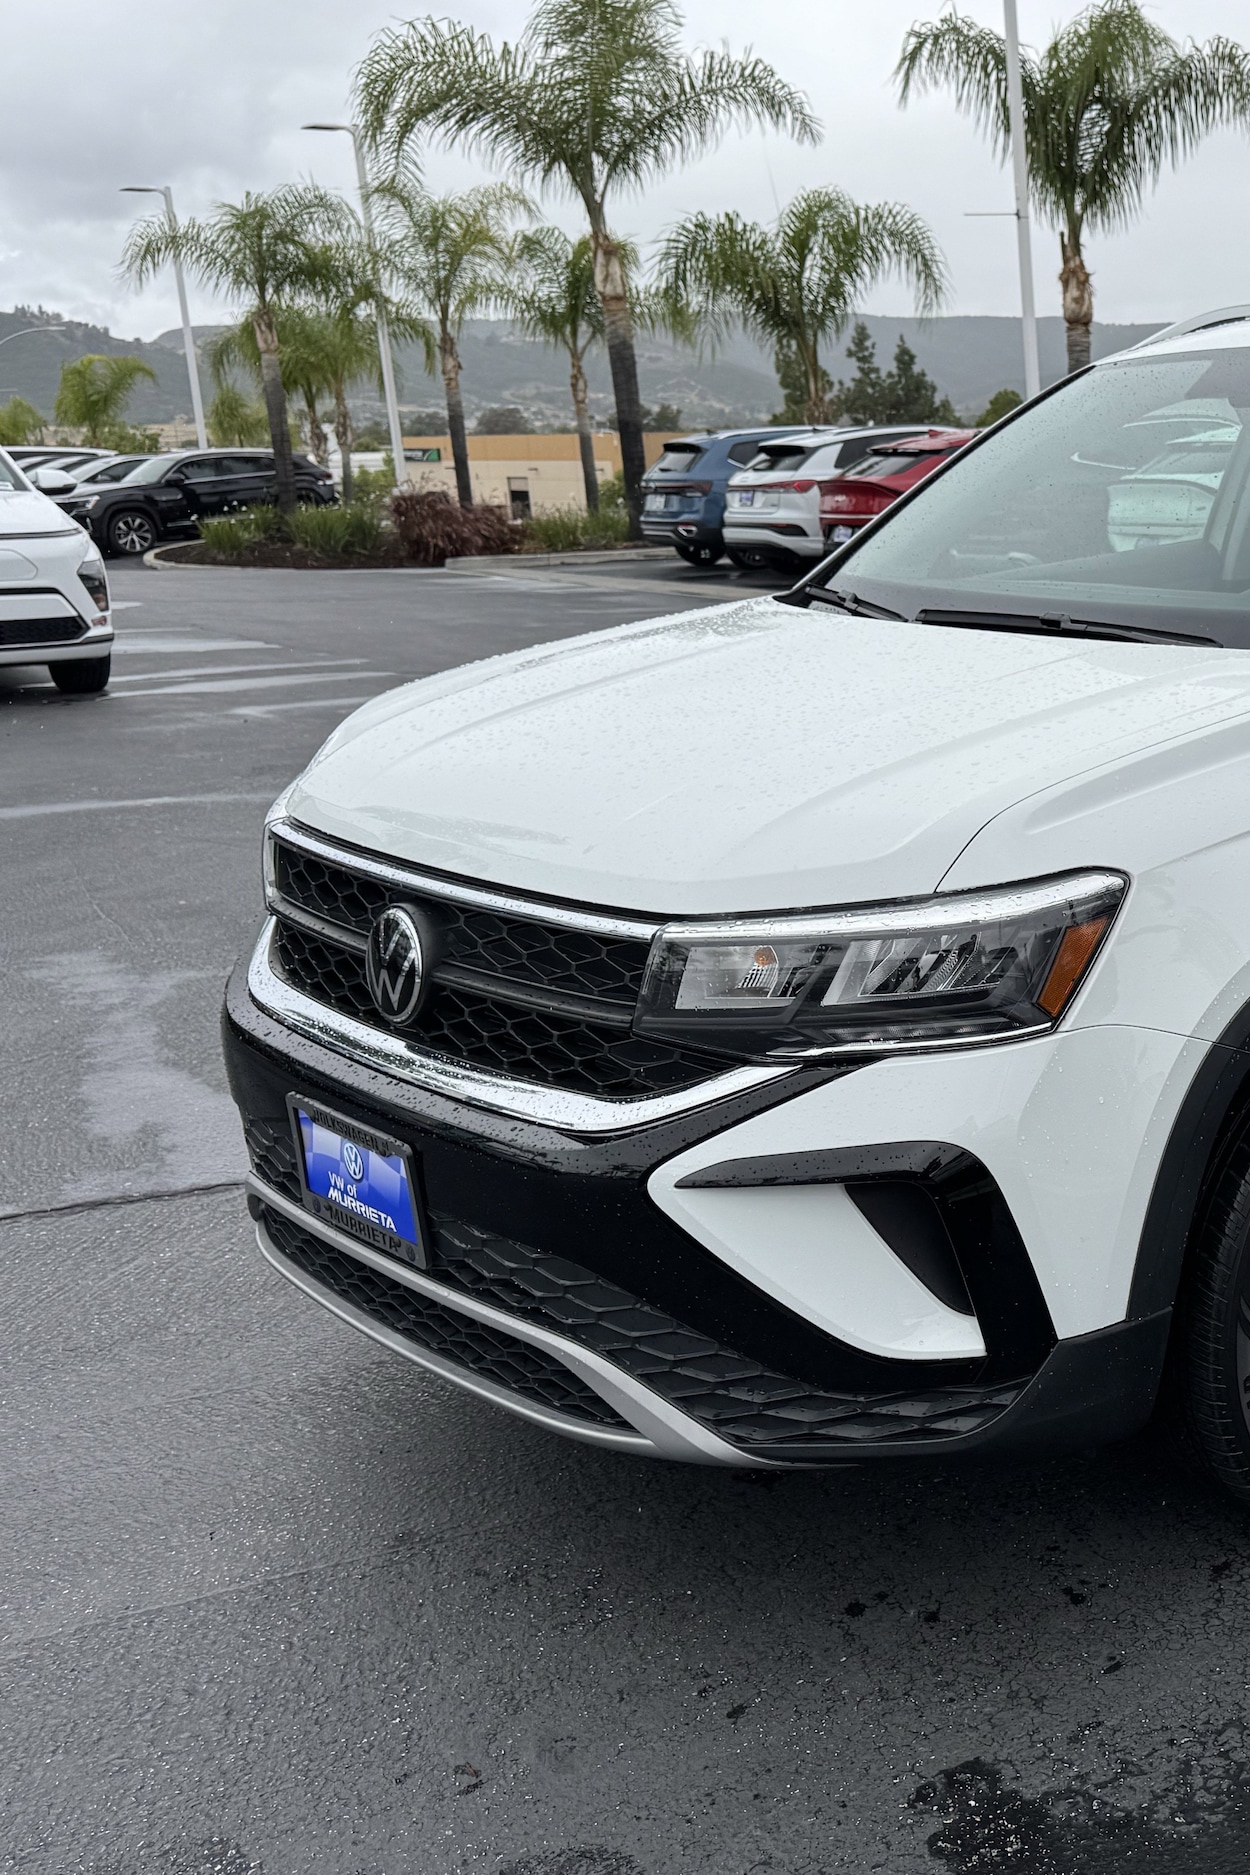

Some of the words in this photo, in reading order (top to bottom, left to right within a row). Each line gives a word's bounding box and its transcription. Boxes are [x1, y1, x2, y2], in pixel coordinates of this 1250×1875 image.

[313, 1107, 379, 1151] VOLKSWAGEN
[328, 1171, 344, 1192] VW
[347, 1184, 357, 1197] of
[328, 1187, 397, 1232] MURRIETA
[329, 1204, 399, 1251] MURRIETA
